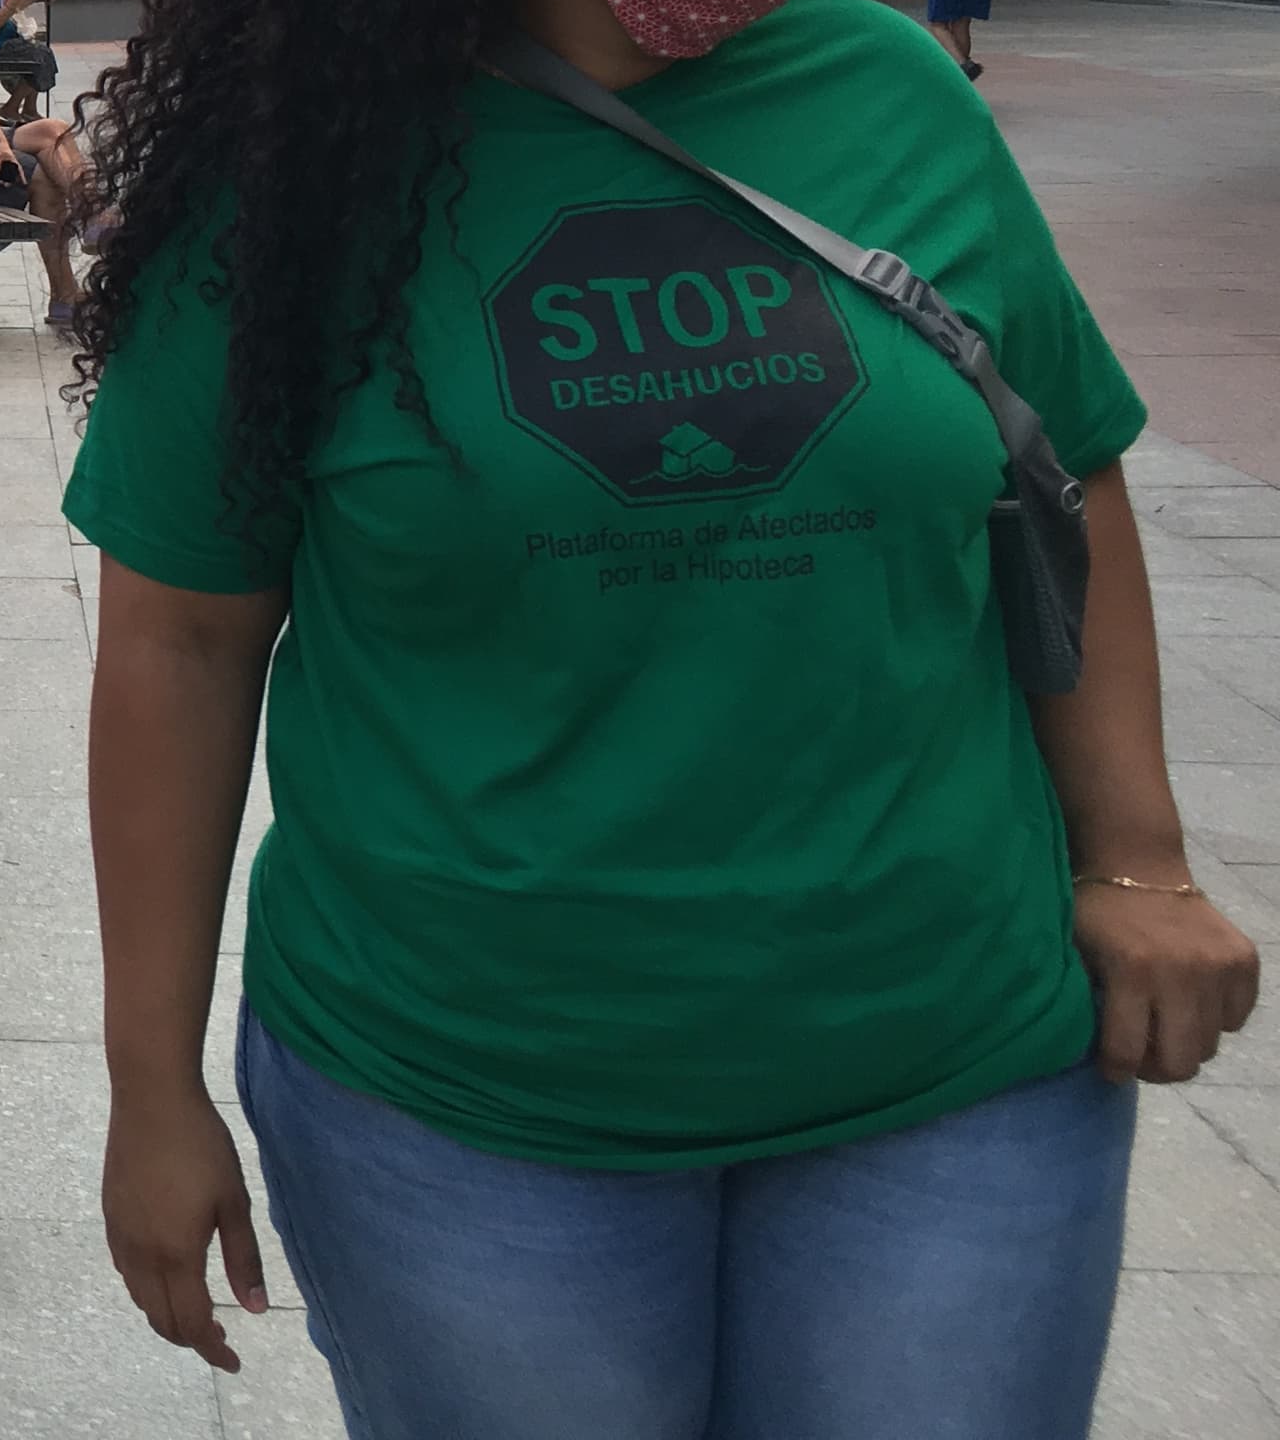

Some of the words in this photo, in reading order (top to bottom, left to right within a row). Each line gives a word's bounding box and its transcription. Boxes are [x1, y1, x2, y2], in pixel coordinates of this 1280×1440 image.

[531, 265, 791, 361] STOP
[550, 352, 826, 410] DESAHUCIOS
[525, 527, 683, 560] Plataforma
[694, 520, 728, 545] de
[738, 504, 877, 541] Afectados
[598, 564, 643, 593] por
[652, 560, 677, 583] la
[687, 552, 815, 585] Hipoteca
